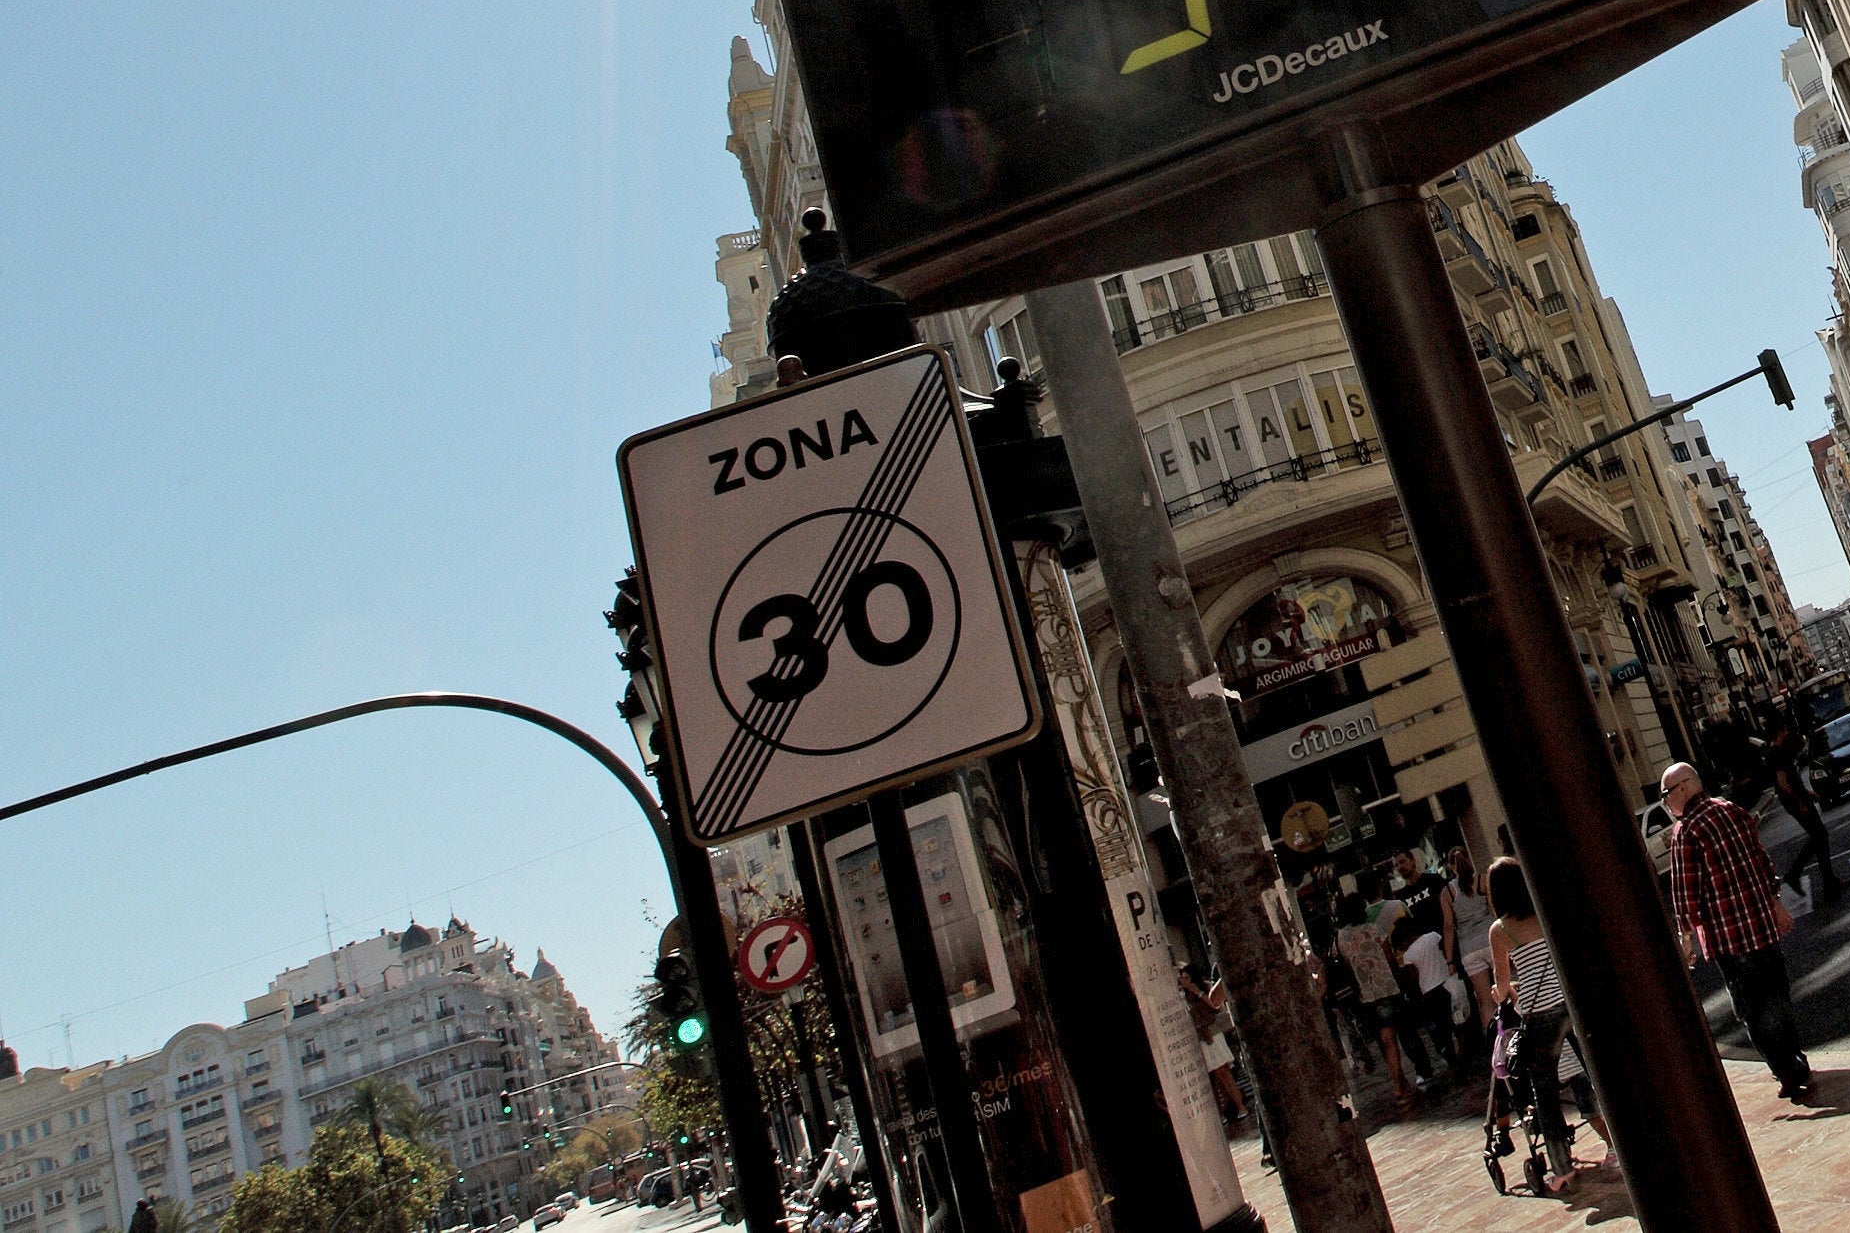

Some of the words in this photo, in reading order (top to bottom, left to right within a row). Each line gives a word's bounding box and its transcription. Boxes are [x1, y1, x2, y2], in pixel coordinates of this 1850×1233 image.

[1212, 18, 1389, 105] JCDecaux
[707, 408, 880, 496] ZONA
[1159, 392, 1366, 478] ENTALIS
[738, 560, 934, 703] 30
[1235, 602, 1379, 666] JOYEIA
[1321, 637, 1375, 666] AGUILAR
[1616, 666, 1637, 681] citi
[1288, 713, 1378, 761] citiban
[1138, 934, 1153, 950] DE
[983, 1096, 1011, 1119] SIM
